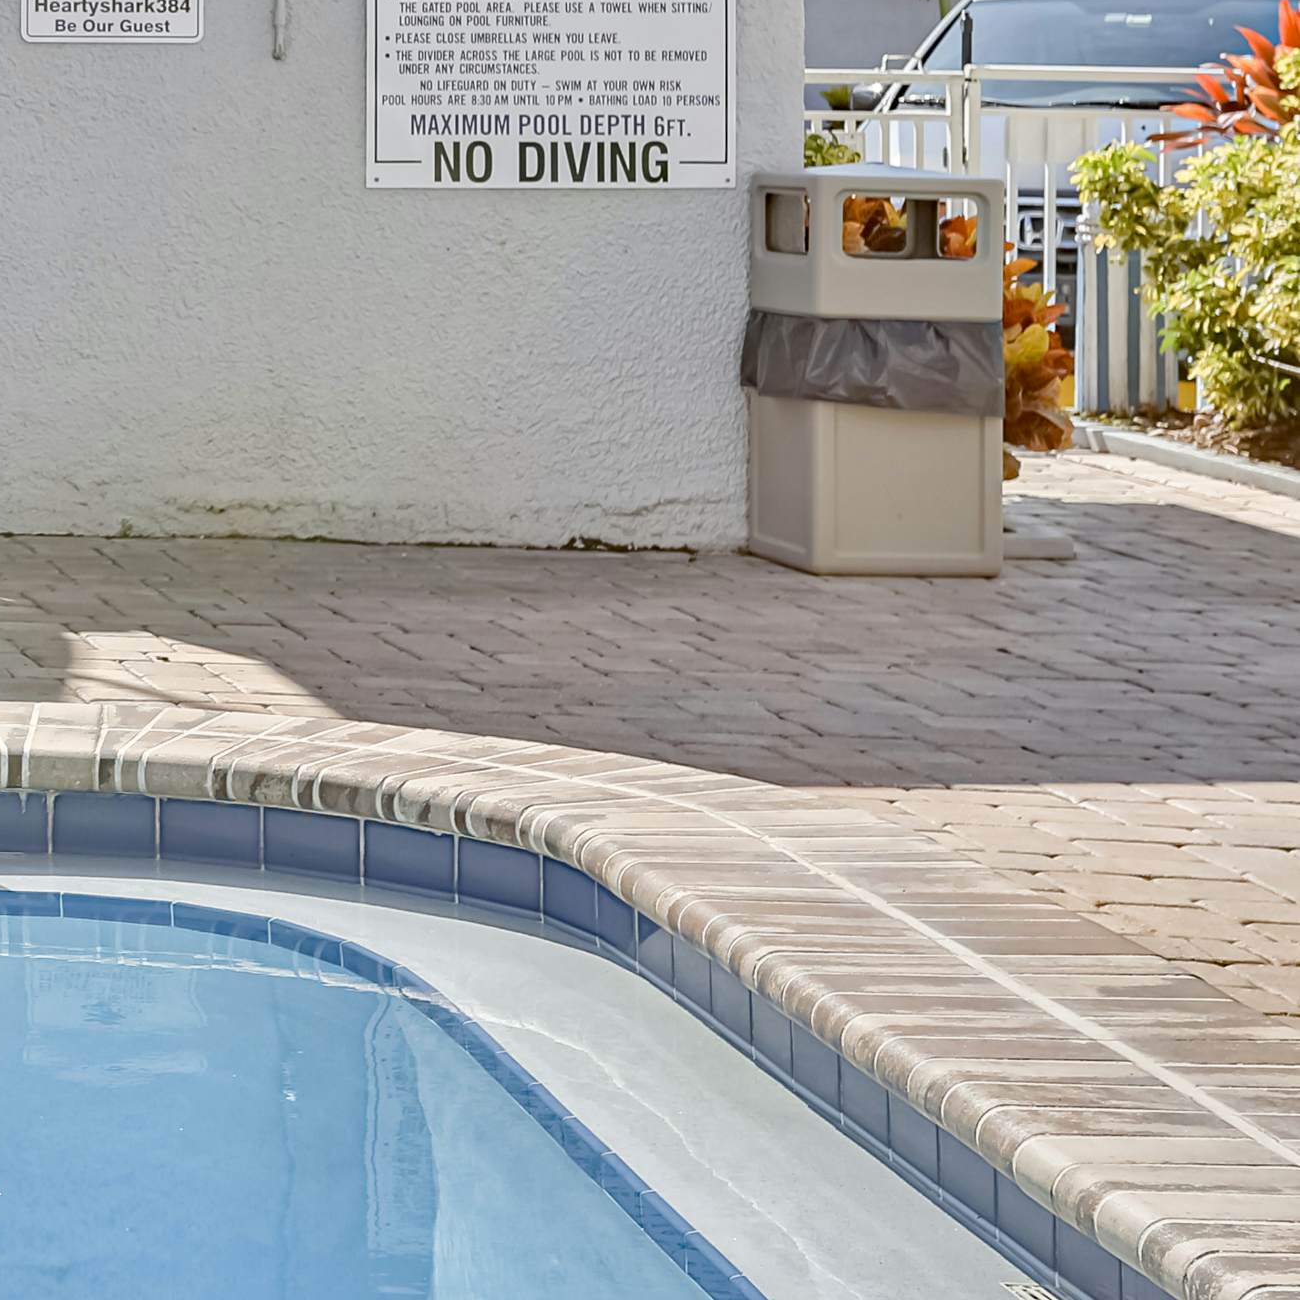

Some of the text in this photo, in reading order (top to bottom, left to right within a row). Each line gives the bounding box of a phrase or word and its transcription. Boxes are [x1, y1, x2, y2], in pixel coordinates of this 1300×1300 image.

[55, 19, 170, 32] Be Our Guest
[395, 50, 708, 61] THE DIVIDER ACROSS THE LARGE POOL IS NOT TO BE REMOVED
[399, 63, 430, 74] UNDER
[435, 63, 454, 74] ANY
[420, 80, 682, 91] NO LIFEGUARD ON DUTY SWIM AT YOUR OWN RISK
[382, 94, 721, 106] POOL HOURS ARE 8:30 AM UNTIL 10 PM BATHING LOAD 10 PERSONS
[410, 114, 510, 136] MAXIMUM
[518, 114, 573, 136] POOL
[580, 114, 645, 136] DEPTH
[433, 140, 670, 183] NO DIVING
